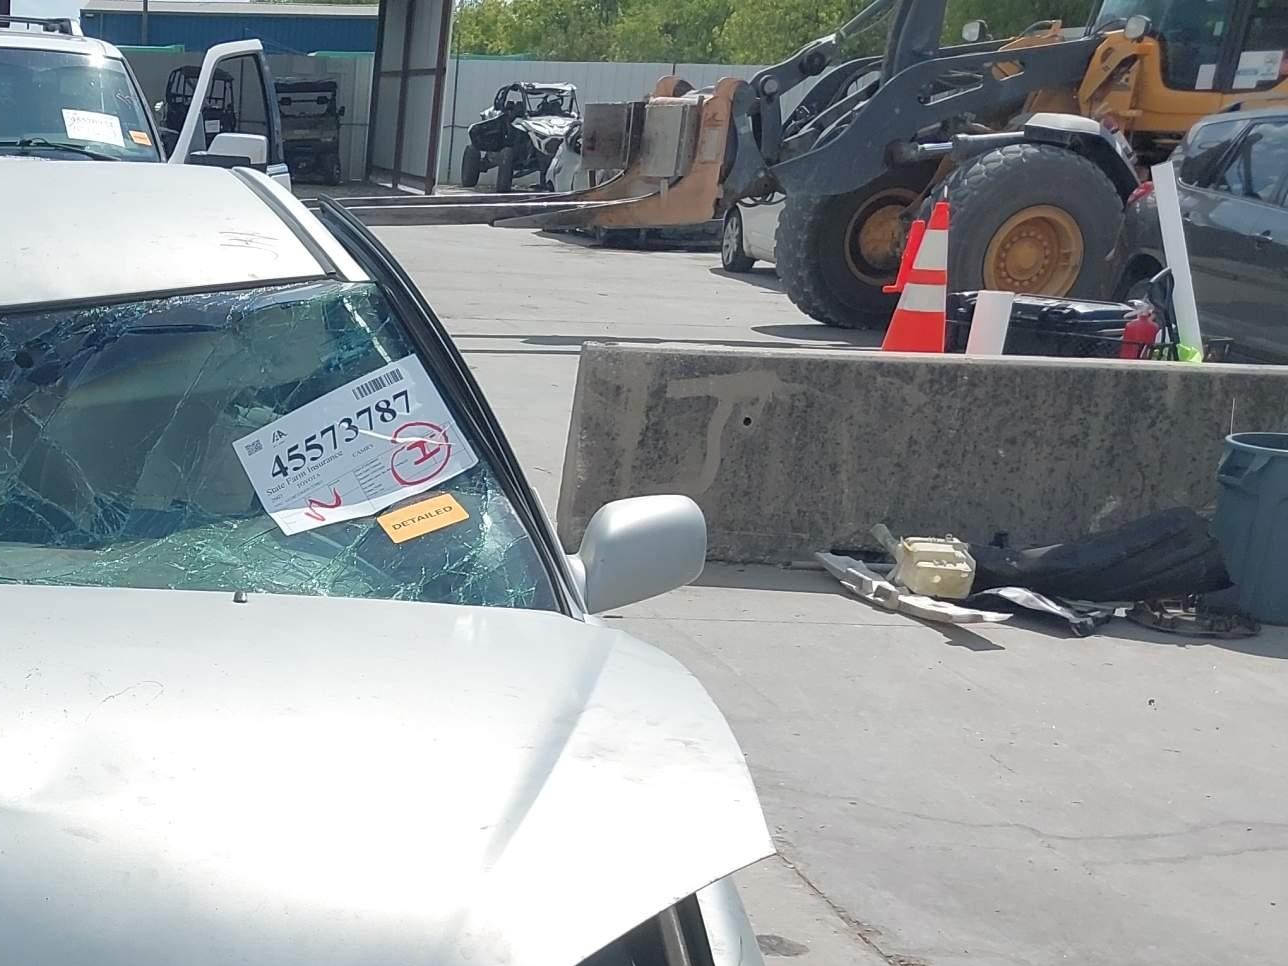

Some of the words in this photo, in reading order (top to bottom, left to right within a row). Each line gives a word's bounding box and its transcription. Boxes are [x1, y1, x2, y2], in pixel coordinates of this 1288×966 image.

[270, 389, 411, 478] 45573787
[266, 482, 286, 496] State
[286, 470, 307, 486] Farm
[306, 450, 344, 473] Insurance
[392, 504, 454, 531] DETAILED
